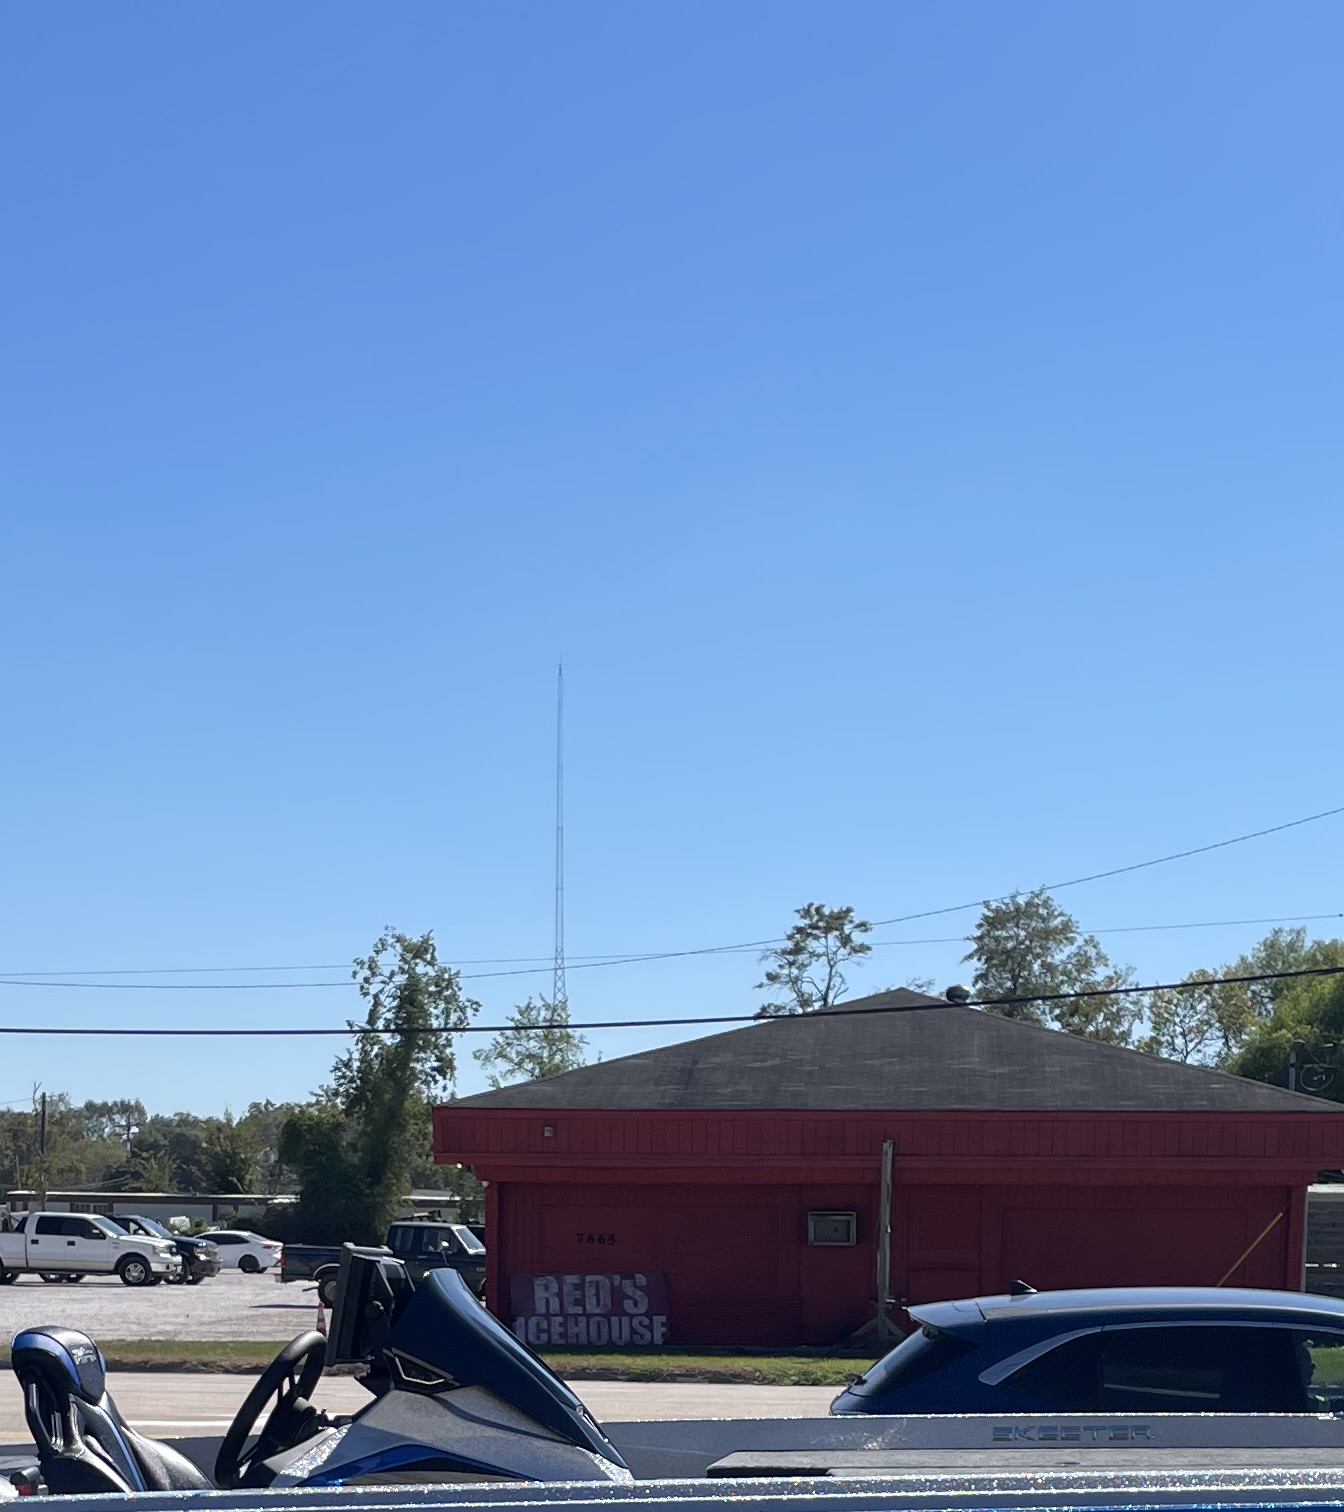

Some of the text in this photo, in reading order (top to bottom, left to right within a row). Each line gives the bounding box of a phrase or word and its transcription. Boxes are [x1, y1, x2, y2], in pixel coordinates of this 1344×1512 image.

[533, 1273, 649, 1315] RED'S
[512, 1315, 668, 1346] ICEHOUSE
[992, 1424, 1153, 1441] SKEETER
